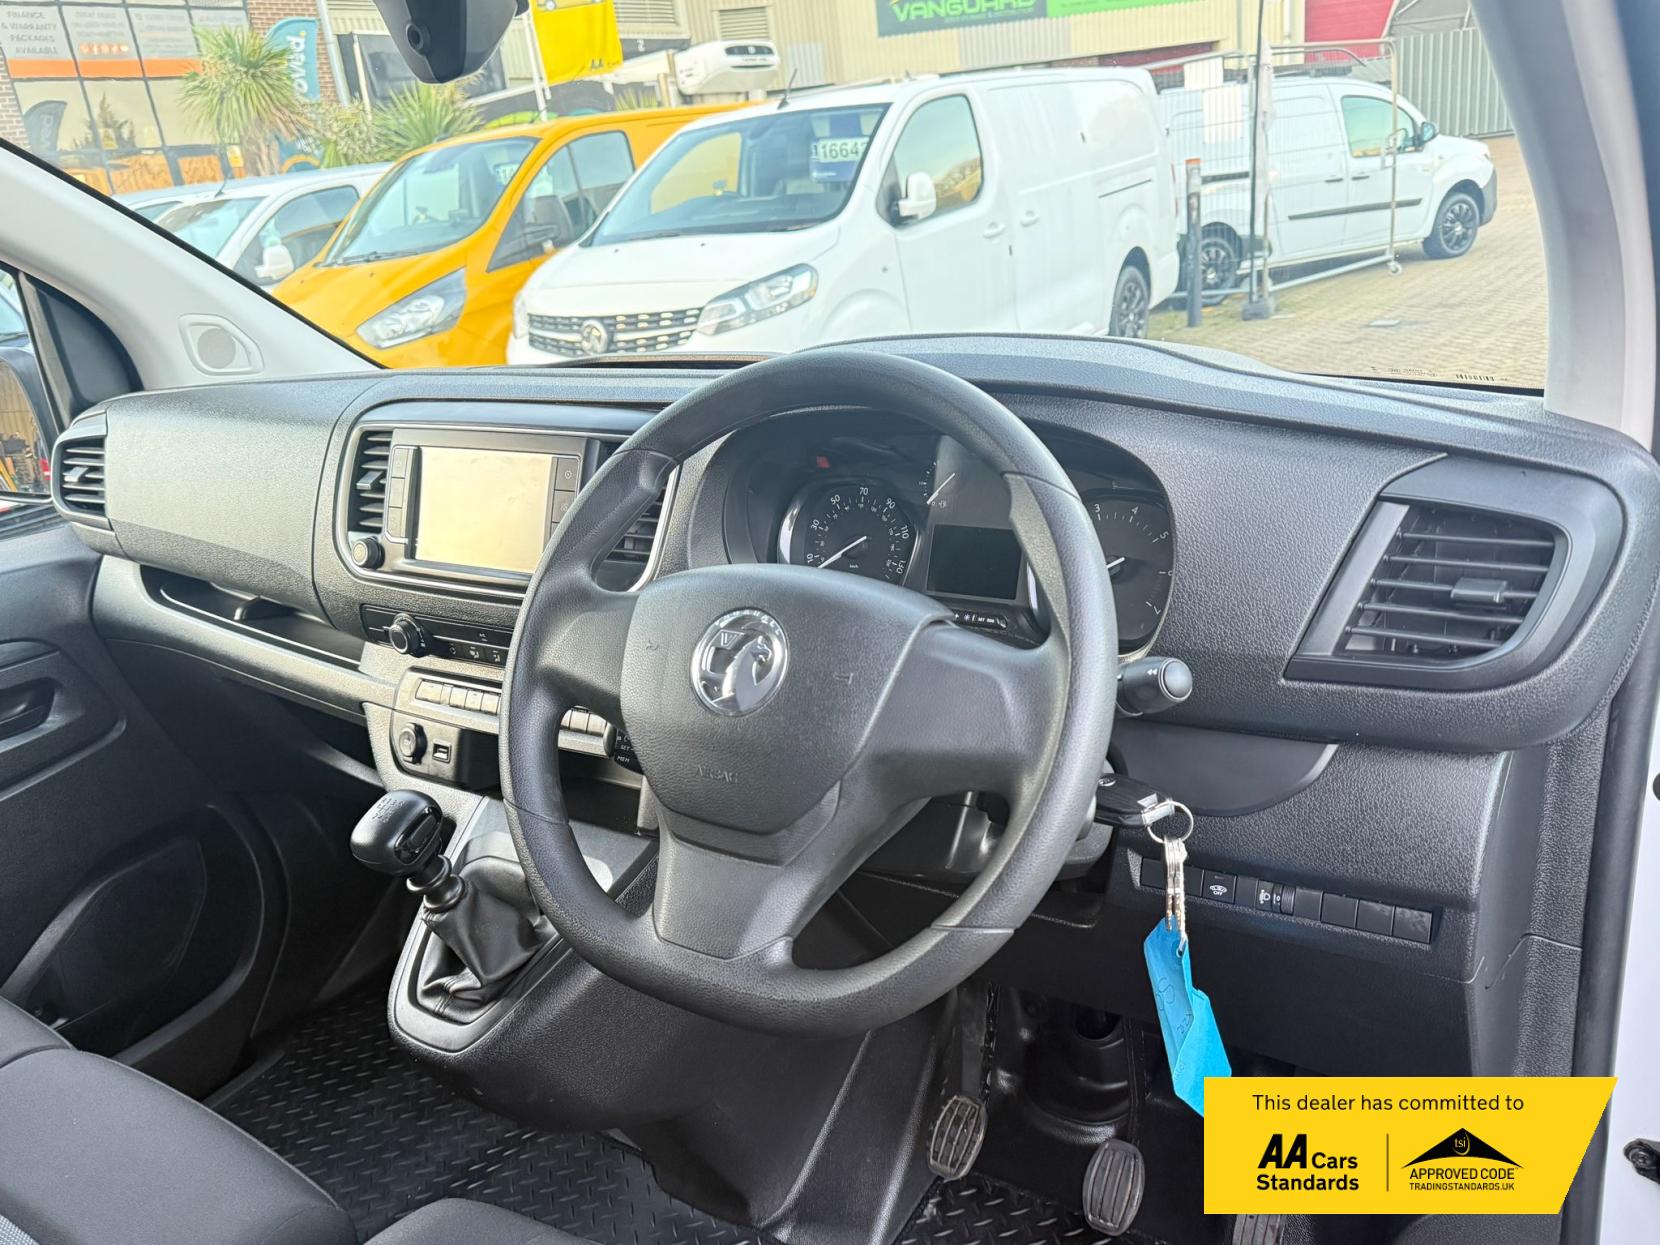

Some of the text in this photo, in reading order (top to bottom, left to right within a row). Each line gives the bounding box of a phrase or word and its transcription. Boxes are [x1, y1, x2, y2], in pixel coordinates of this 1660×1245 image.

[859, 487, 869, 496] 70
[830, 494, 841, 506] 50
[885, 497, 896, 510] 90
[1095, 503, 1101, 513] 3
[1131, 506, 1139, 515] 4
[811, 519, 820, 531] 30
[901, 524, 910, 540] 110
[1159, 530, 1169, 540] 5
